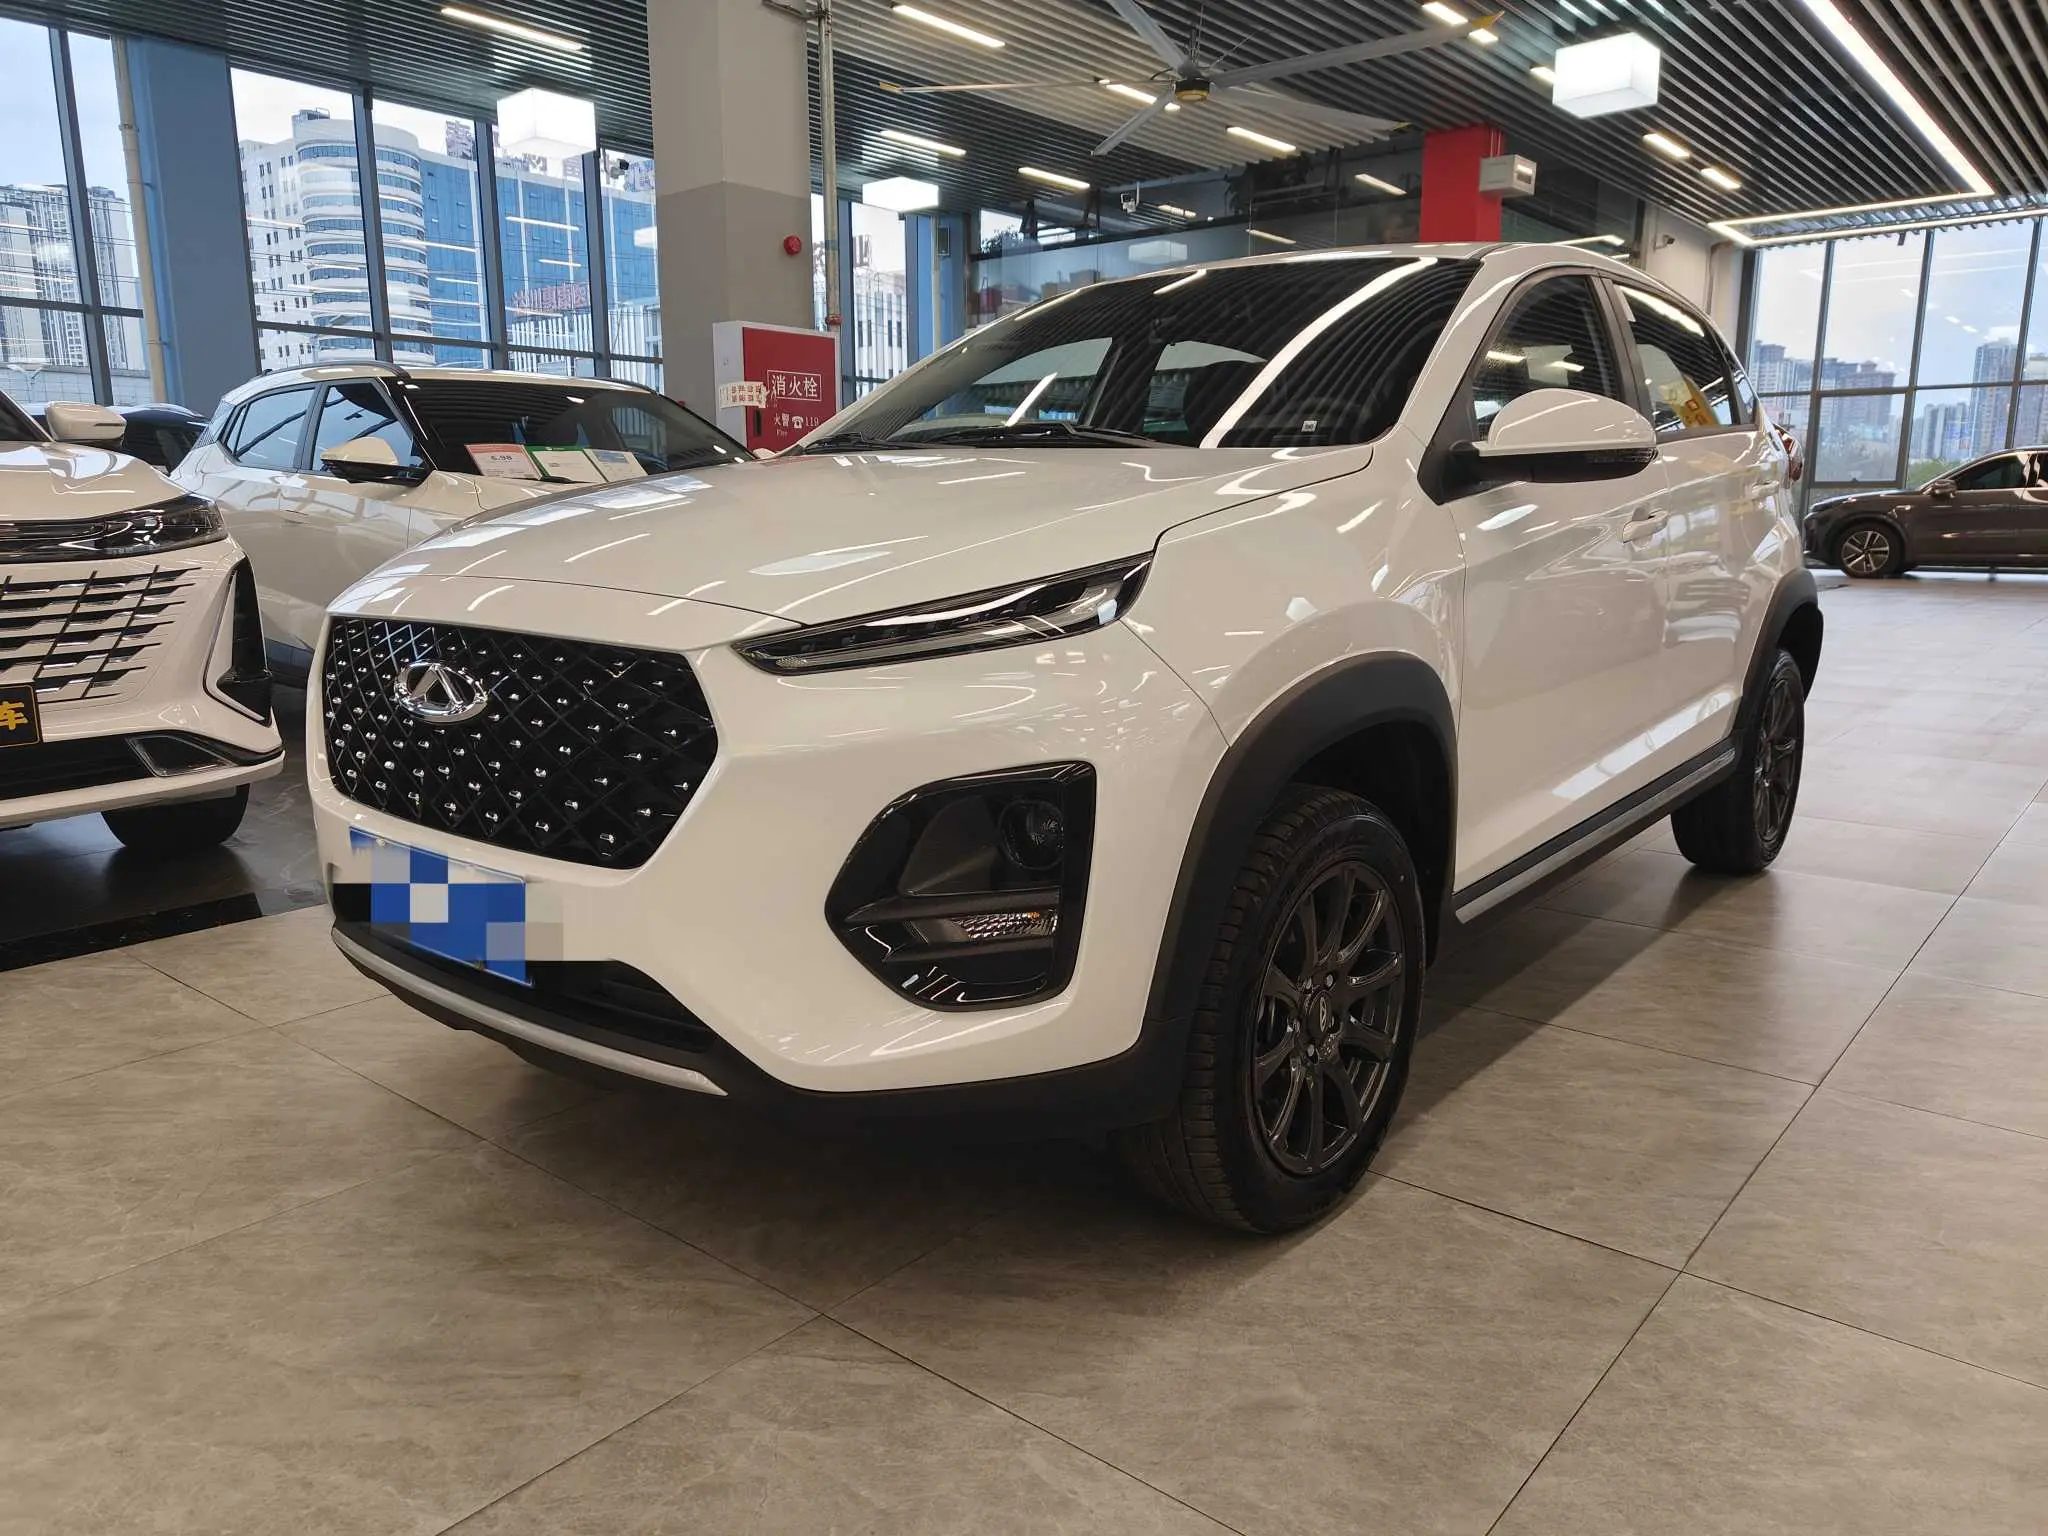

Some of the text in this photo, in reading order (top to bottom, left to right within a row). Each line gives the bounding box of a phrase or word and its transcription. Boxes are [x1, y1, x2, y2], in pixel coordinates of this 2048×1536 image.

[772, 374, 818, 398] 消火栓
[774, 412, 790, 427] 火警
